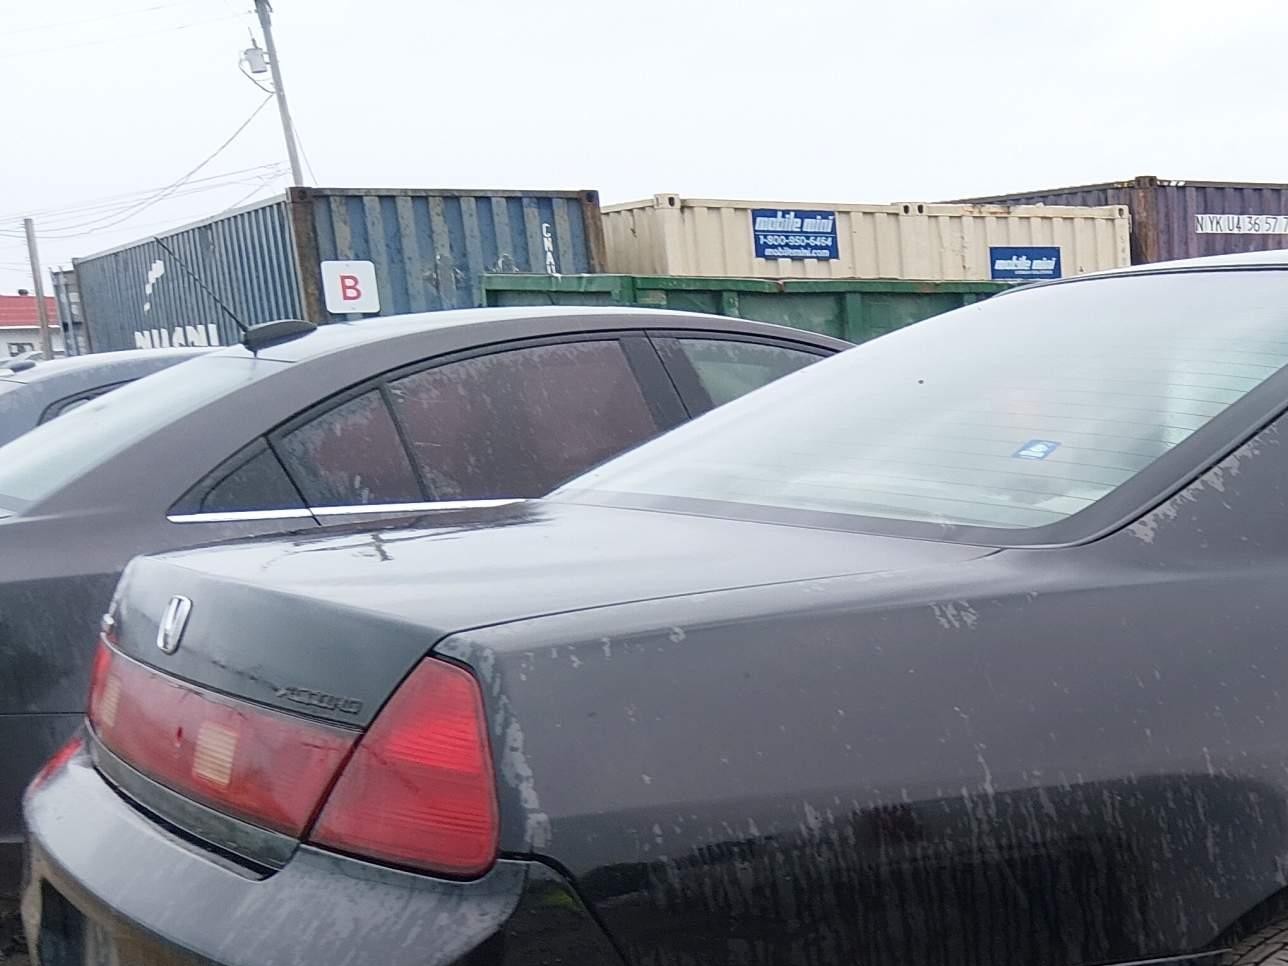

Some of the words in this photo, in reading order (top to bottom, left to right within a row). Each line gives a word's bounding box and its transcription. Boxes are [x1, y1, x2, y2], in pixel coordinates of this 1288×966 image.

[755, 211, 801, 231] mobile
[803, 215, 834, 233] mini
[340, 275, 362, 301] B
